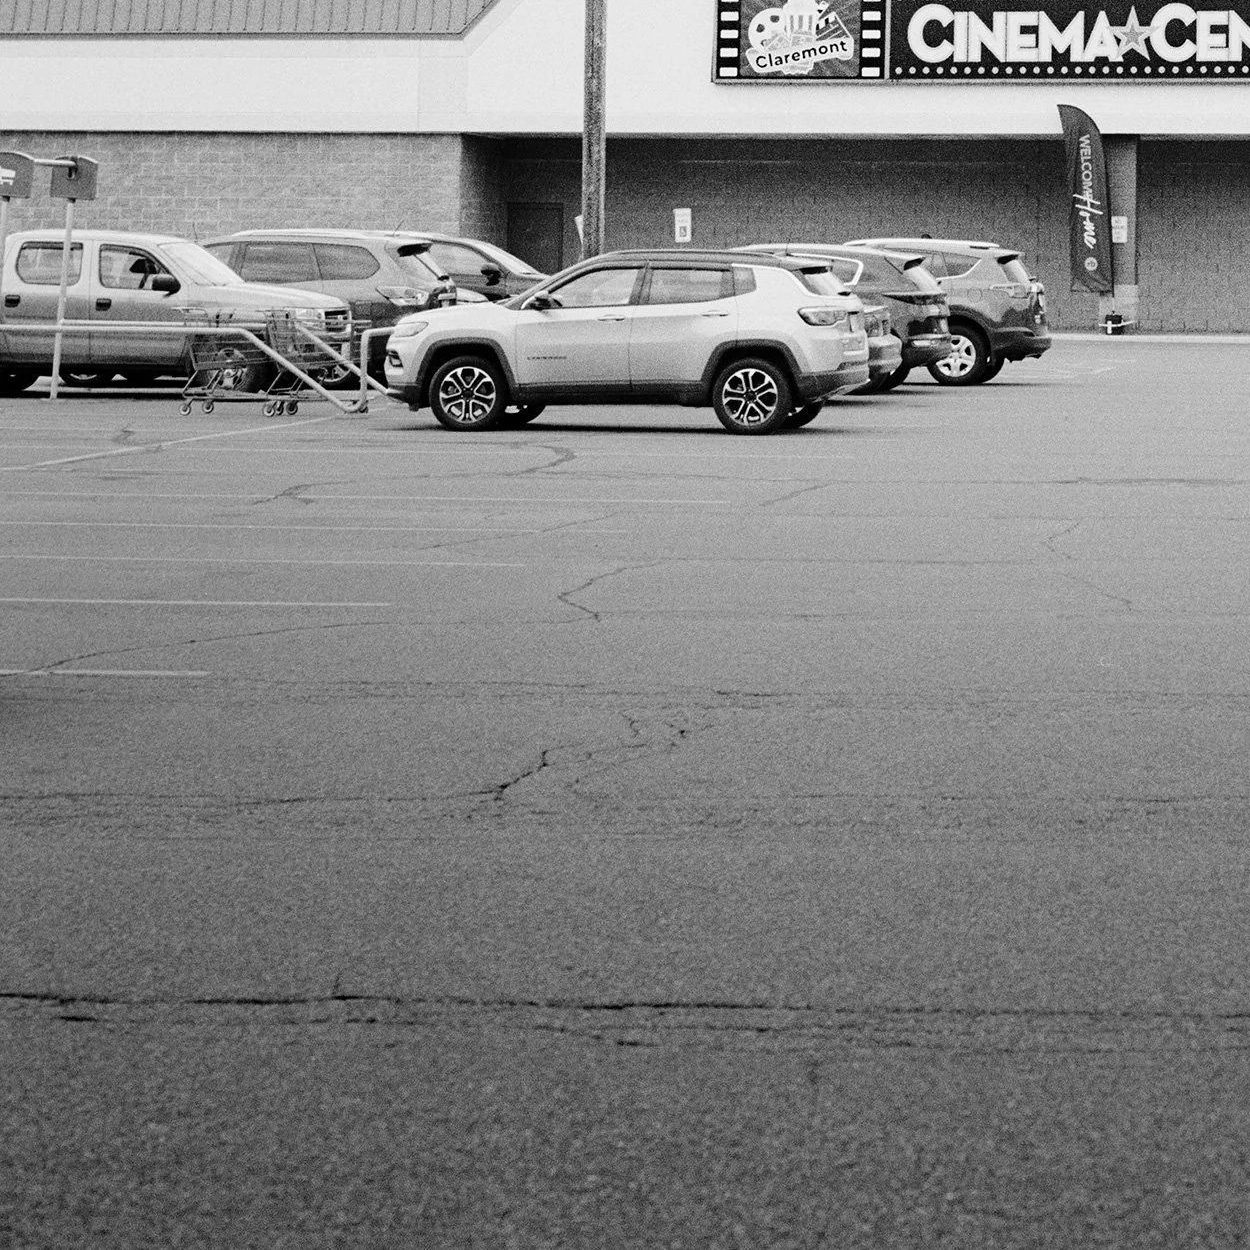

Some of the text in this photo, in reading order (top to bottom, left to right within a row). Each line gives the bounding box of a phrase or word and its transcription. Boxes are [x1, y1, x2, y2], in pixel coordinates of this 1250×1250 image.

[756, 40, 847, 68] Claremont
[907, 3, 1124, 63] CINEMA
[1079, 134, 1093, 202] WELCOME
[1072, 194, 1103, 249] Home
